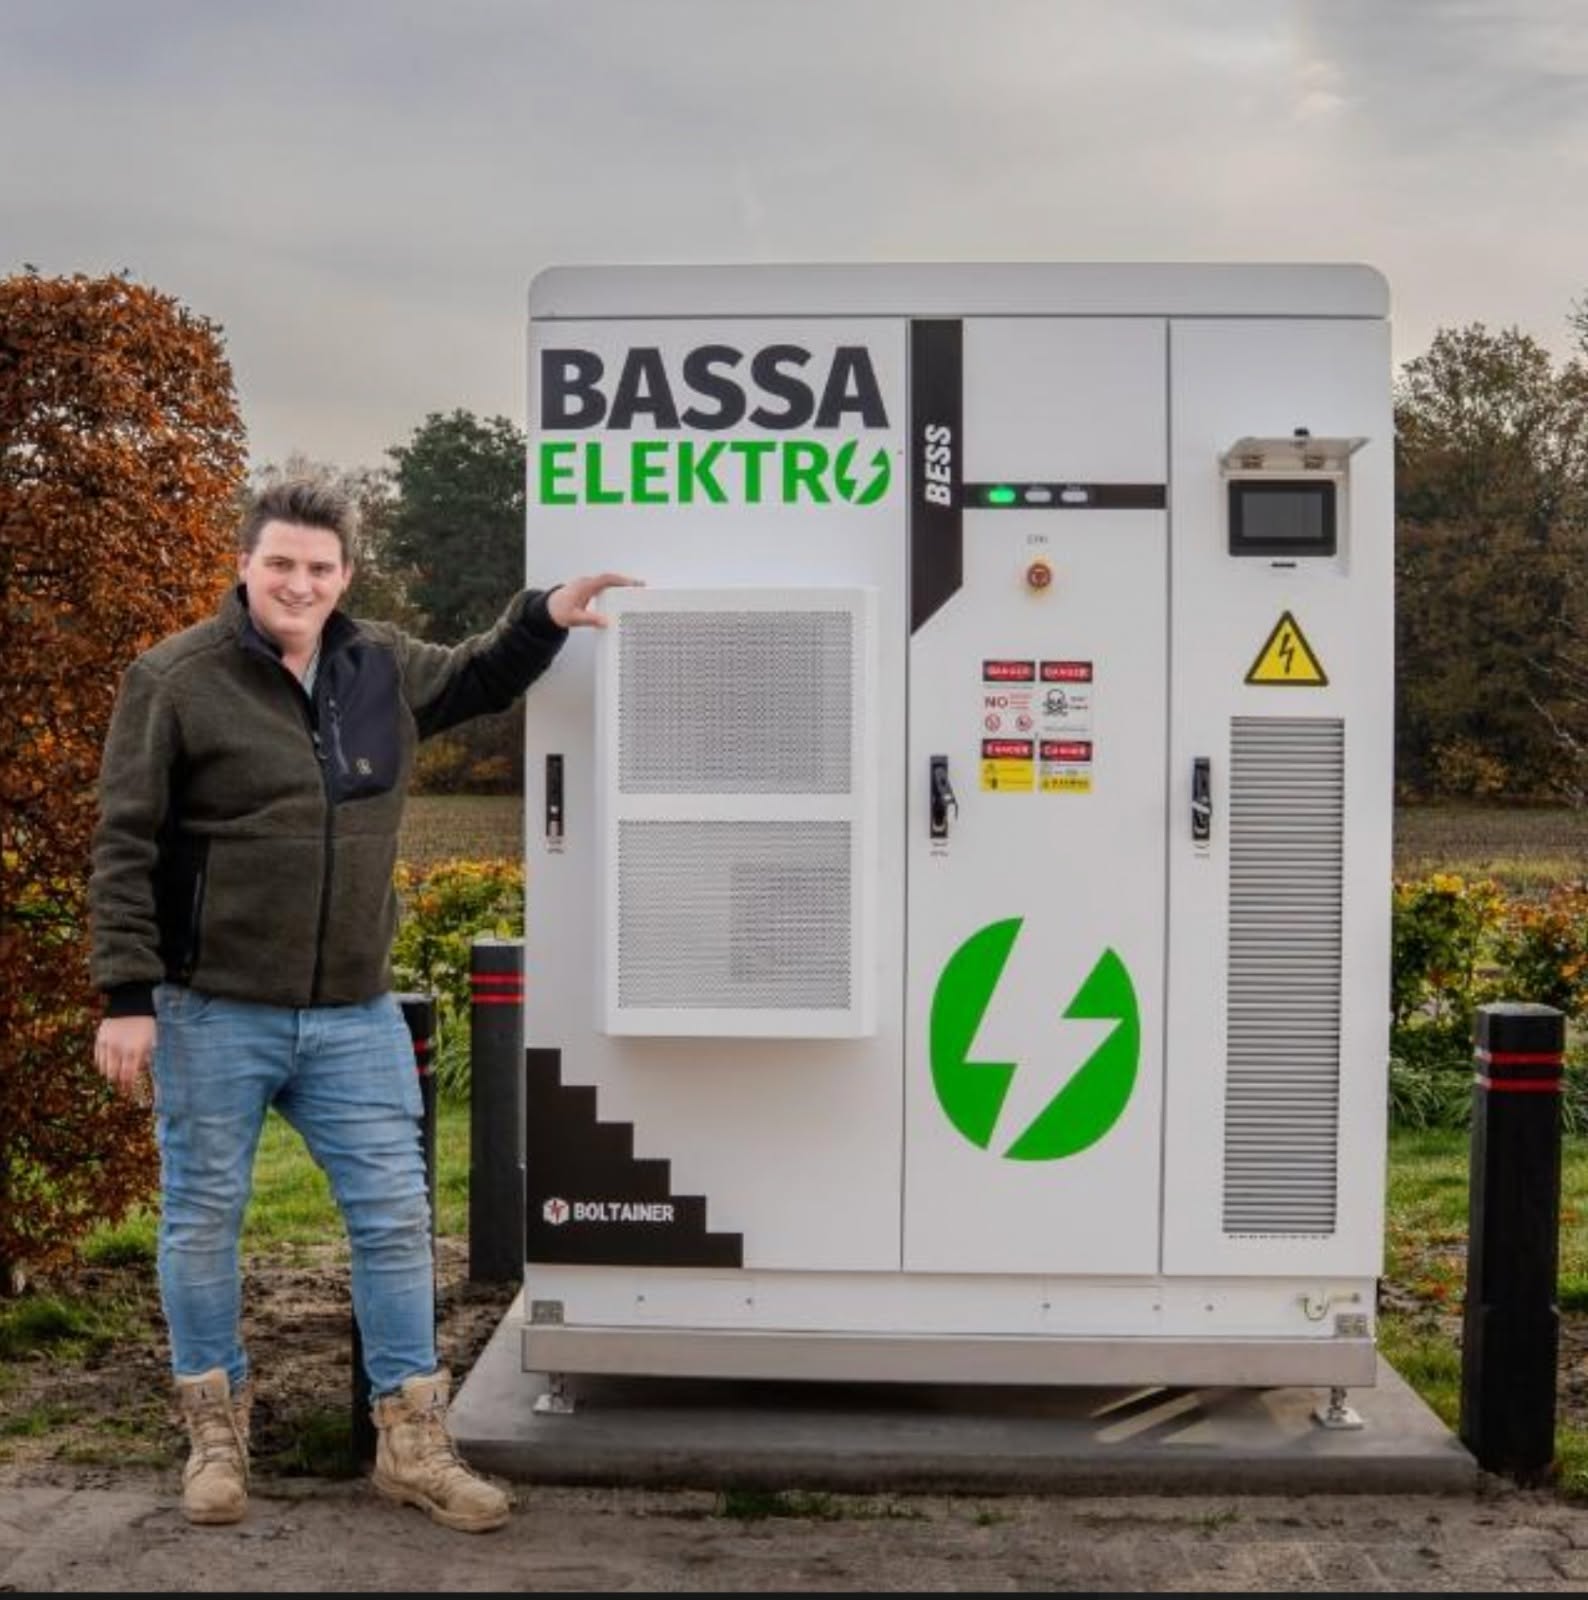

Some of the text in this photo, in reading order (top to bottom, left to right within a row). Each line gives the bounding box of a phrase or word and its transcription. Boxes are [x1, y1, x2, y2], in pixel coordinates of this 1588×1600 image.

[542, 345, 888, 430] BASSA
[539, 440, 891, 506] ELEKTRO
[925, 425, 953, 506] BESS
[984, 696, 1008, 709] NO
[573, 1202, 674, 1222] BOLTAINER
